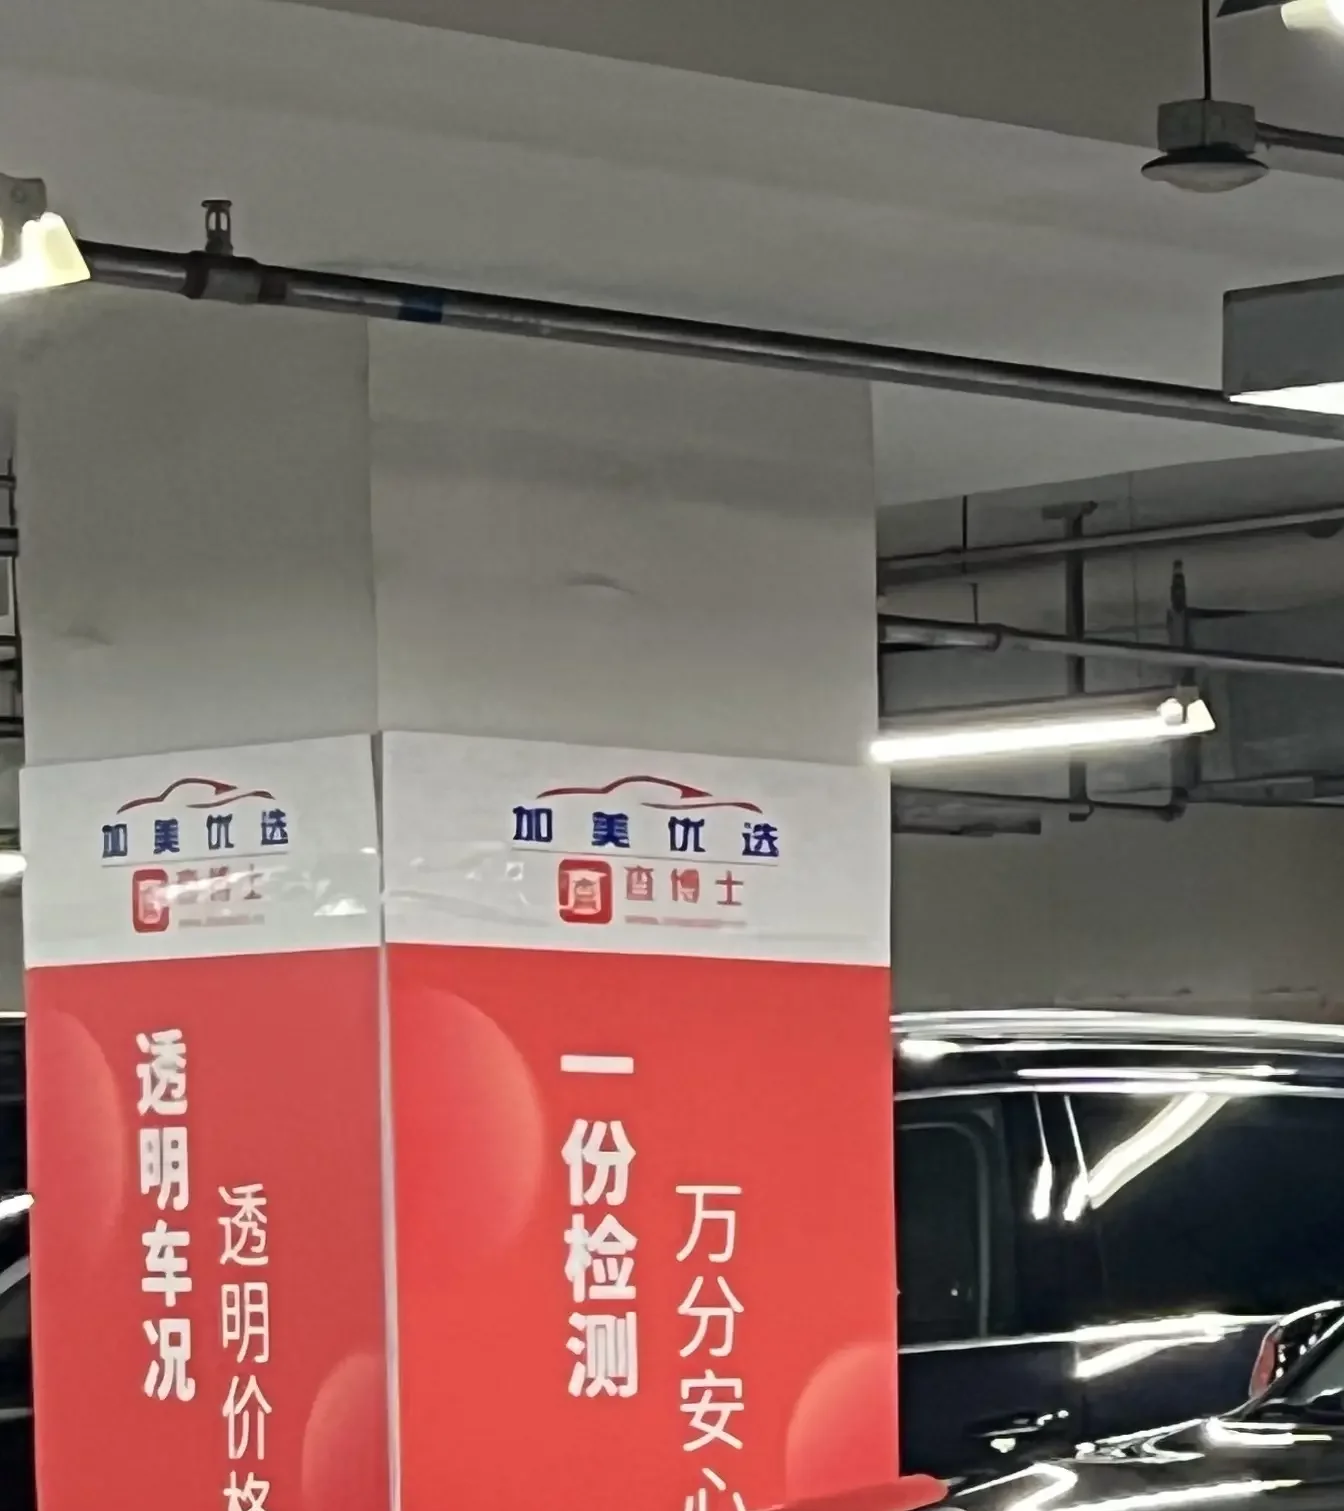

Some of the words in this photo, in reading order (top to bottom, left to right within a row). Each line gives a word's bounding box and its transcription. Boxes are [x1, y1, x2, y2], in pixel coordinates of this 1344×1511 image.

[512, 806, 779, 857] 加美优选
[135, 1028, 196, 1402] 透明车况
[560, 1054, 639, 1398] 一份检测
